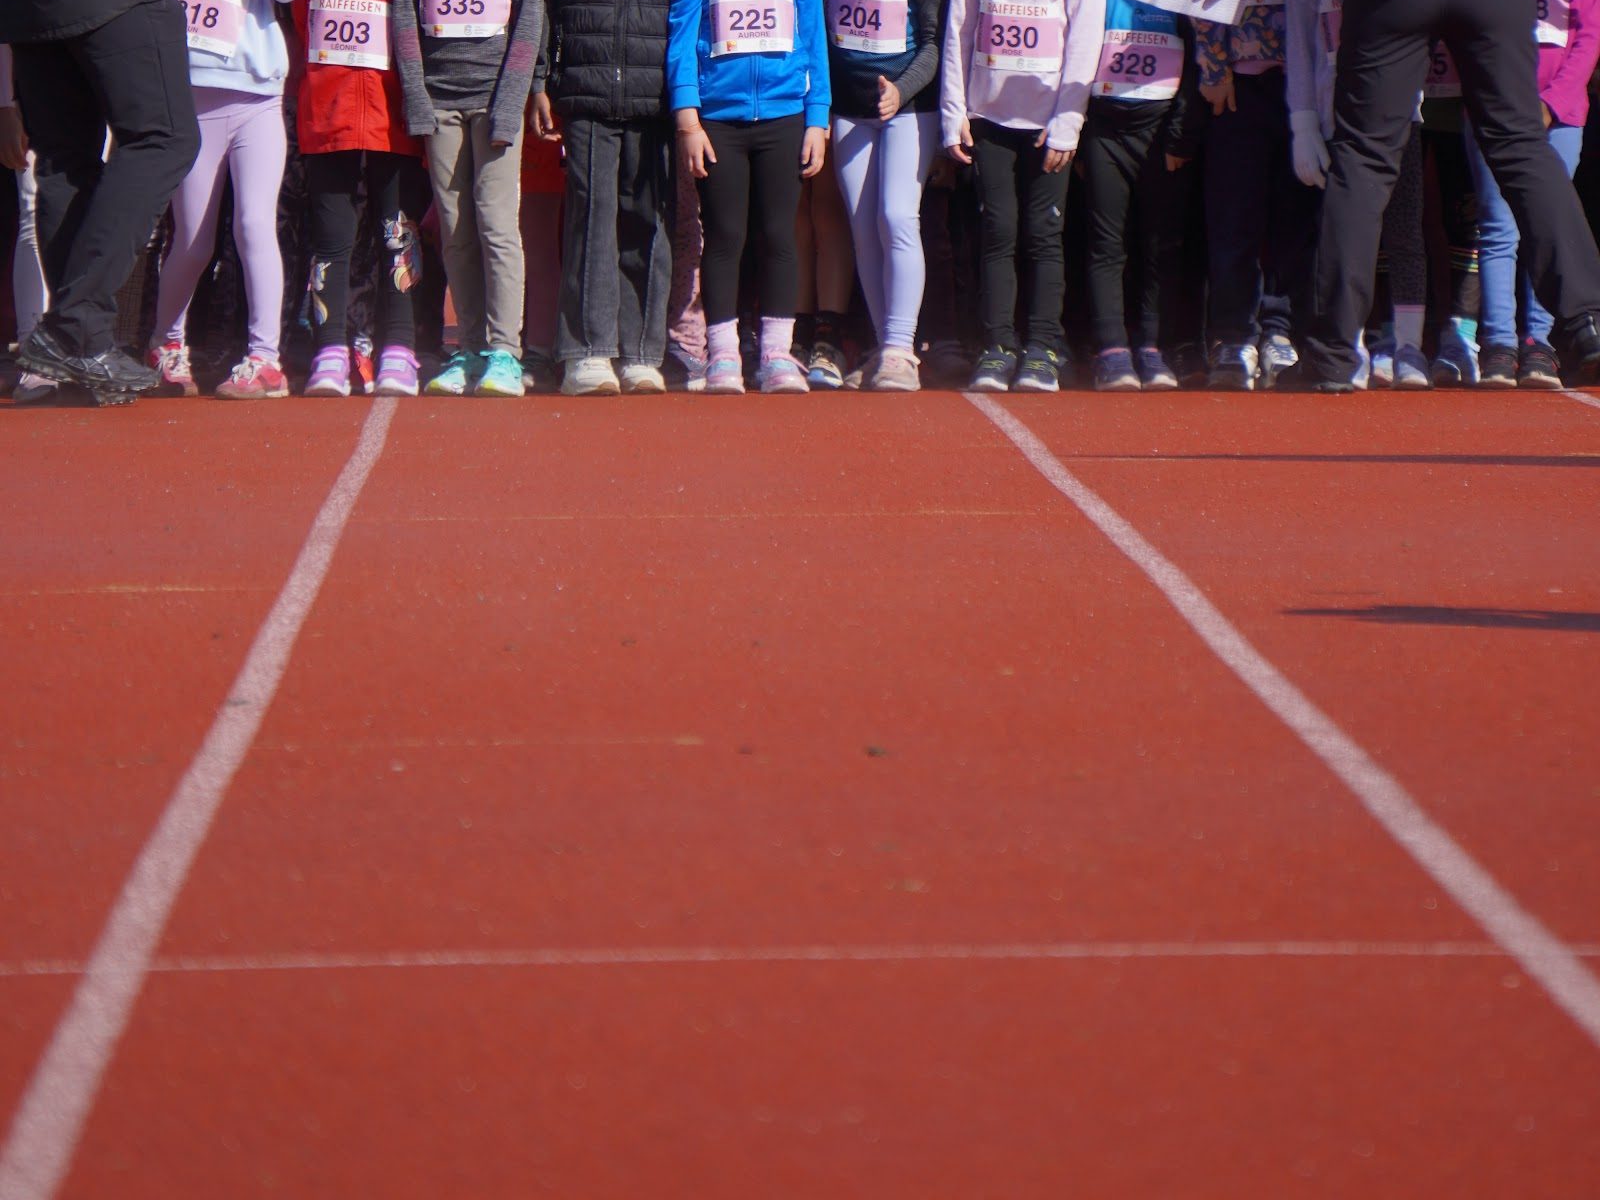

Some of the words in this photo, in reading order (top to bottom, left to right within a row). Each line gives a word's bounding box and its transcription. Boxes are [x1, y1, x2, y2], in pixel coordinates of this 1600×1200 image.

[180, 0, 219, 29] 18
[729, 7, 777, 31] 225
[839, 4, 882, 31] 204
[987, 2, 1048, 17] RAIFFEISEN
[187, 26, 199, 34] UN
[324, 19, 370, 45] 203
[738, 30, 772, 39] AURORE
[848, 29, 870, 38] ALICE
[991, 24, 1039, 49] 330
[1107, 31, 1169, 45] RAIFFEISEN
[331, 43, 358, 52] LÉONIE
[1109, 51, 1157, 77] 328
